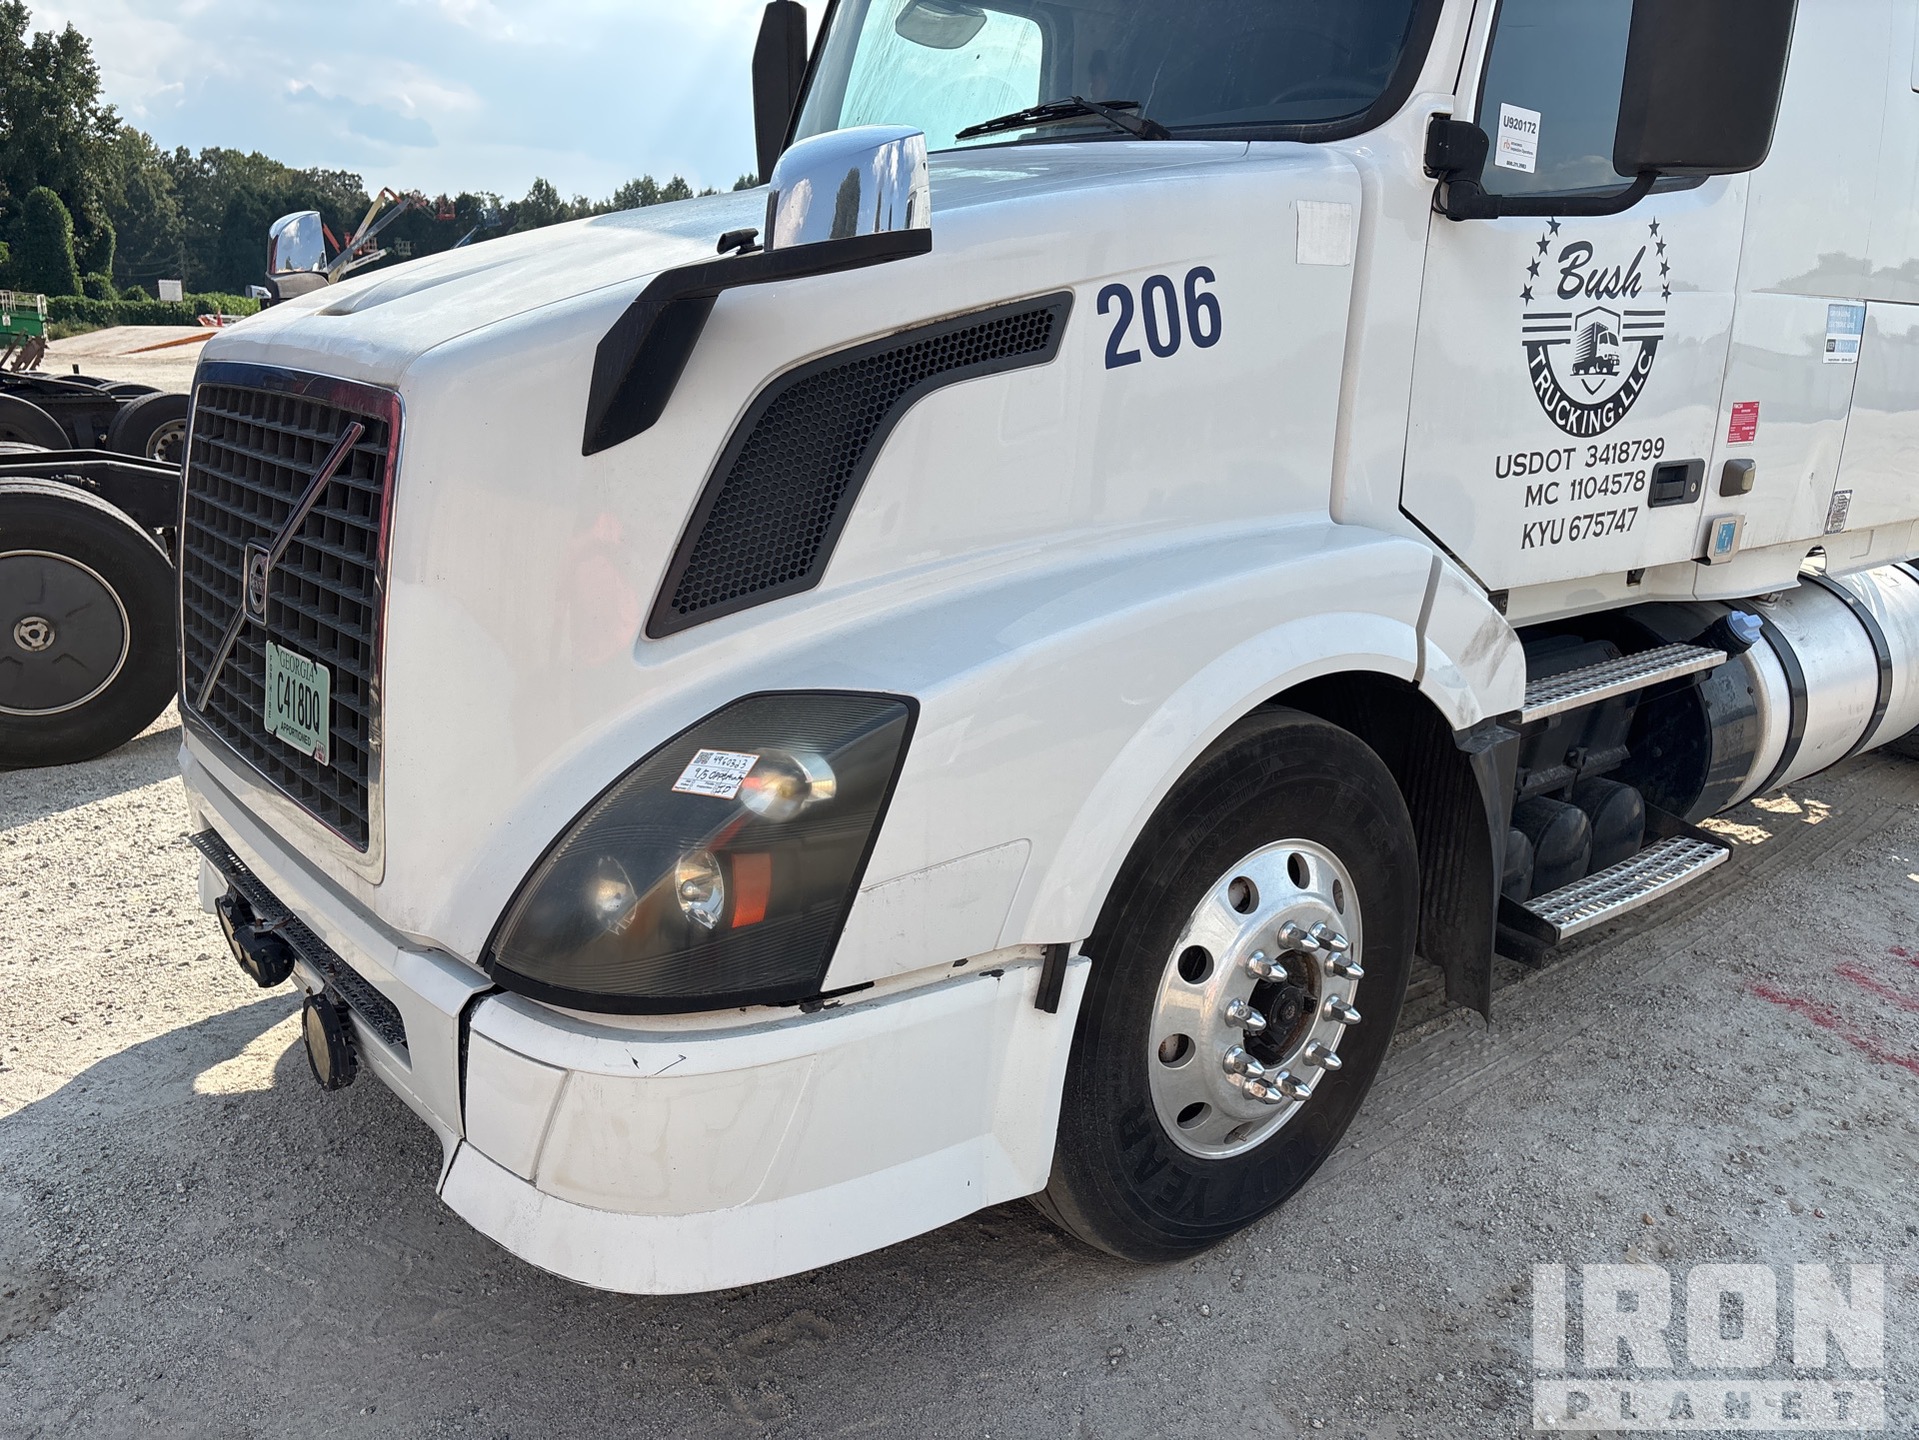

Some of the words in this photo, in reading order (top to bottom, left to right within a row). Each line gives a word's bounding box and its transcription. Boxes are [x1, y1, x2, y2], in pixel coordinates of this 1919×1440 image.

[1503, 115, 1537, 134] U920172
[1556, 240, 1647, 300] Bush
[1096, 265, 1222, 370] 206
[1495, 447, 1576, 480] USDOT
[1584, 437, 1665, 469] 3418799
[1524, 481, 1560, 508] MC
[1569, 470, 1646, 502] 1104578
[1520, 518, 1566, 550] KYU
[1568, 506, 1639, 542] 675747
[279, 651, 315, 684] GEORGIA
[277, 671, 320, 735] C418DQ
[280, 721, 312, 747] APPORTIONED
